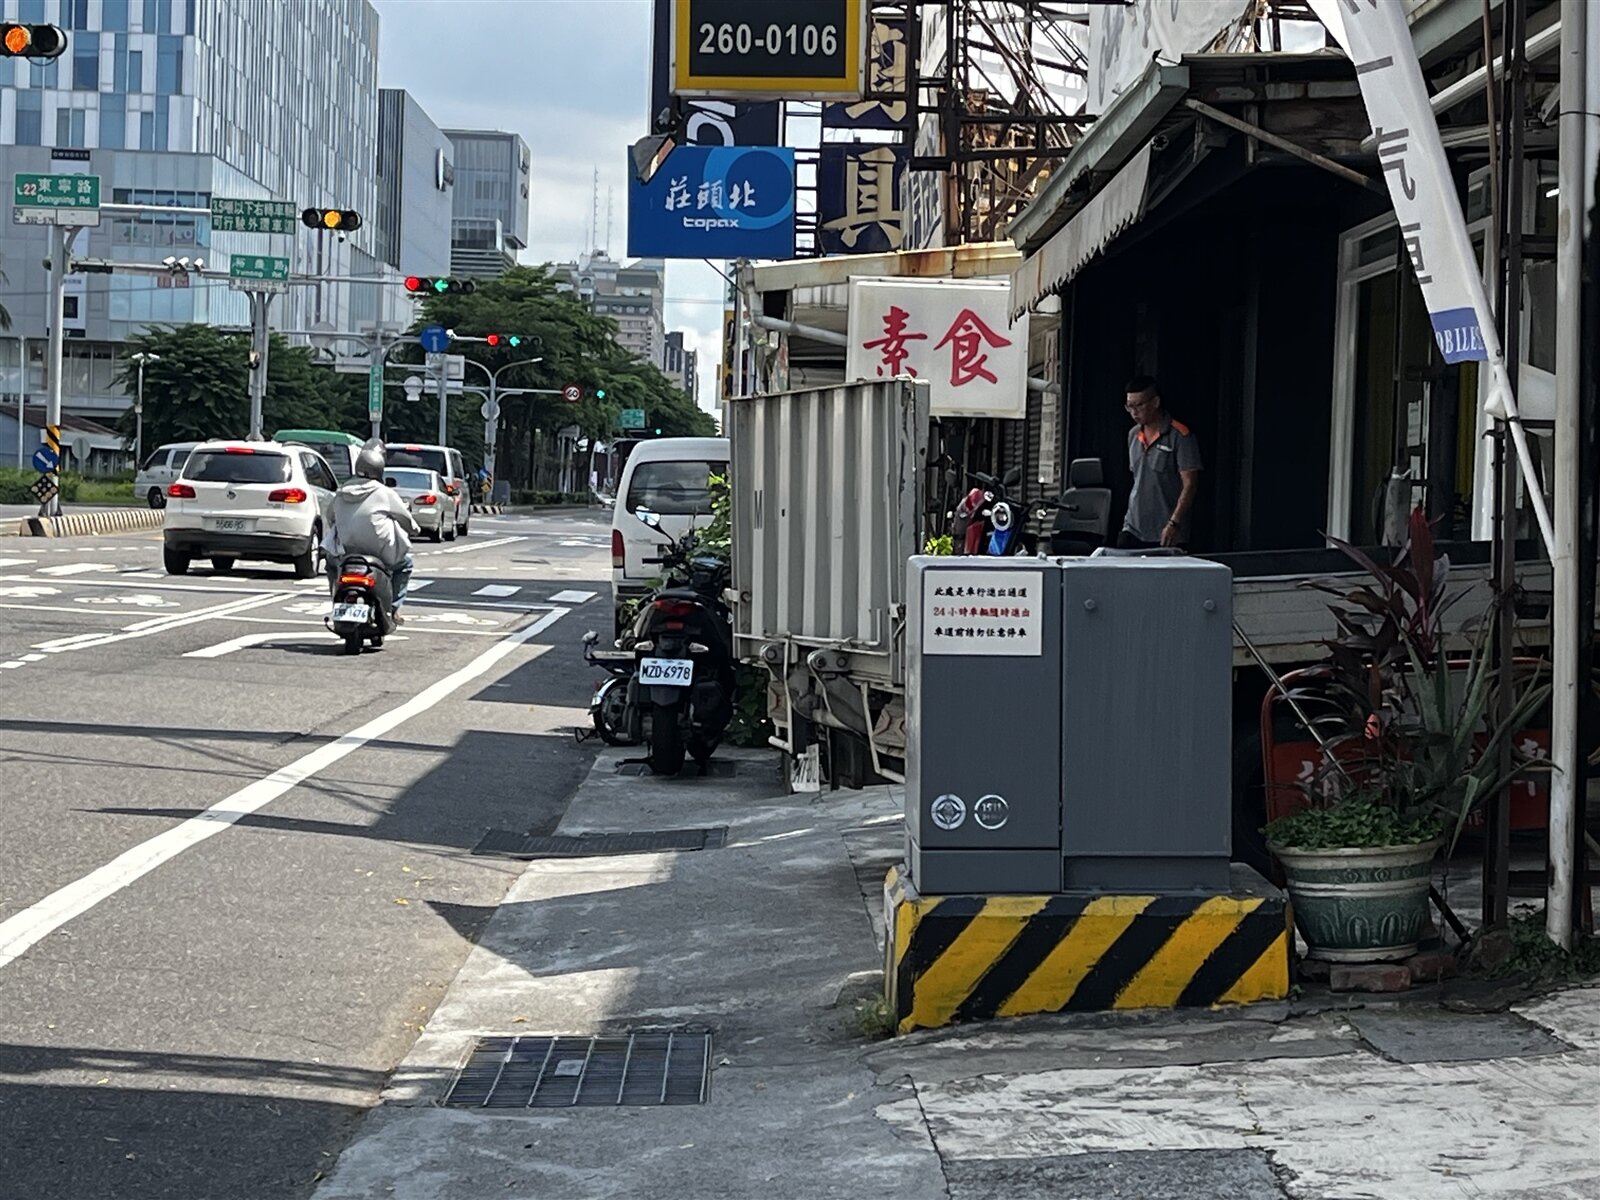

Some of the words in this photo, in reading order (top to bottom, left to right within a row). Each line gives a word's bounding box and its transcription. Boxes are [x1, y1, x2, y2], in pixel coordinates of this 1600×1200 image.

[699, 23, 837, 55] 260-0106
[38, 178, 92, 193] 東寧路
[37, 195, 76, 206] Dongning
[665, 176, 756, 211] 莊頭北
[683, 216, 740, 231] topax
[863, 305, 1012, 387] 素食
[567, 389, 579, 398] 60
[934, 586, 1028, 598] 此處是車行進出通道
[934, 626, 1027, 638] 車道前請勿任意停車
[641, 665, 691, 680] MZD-6978
